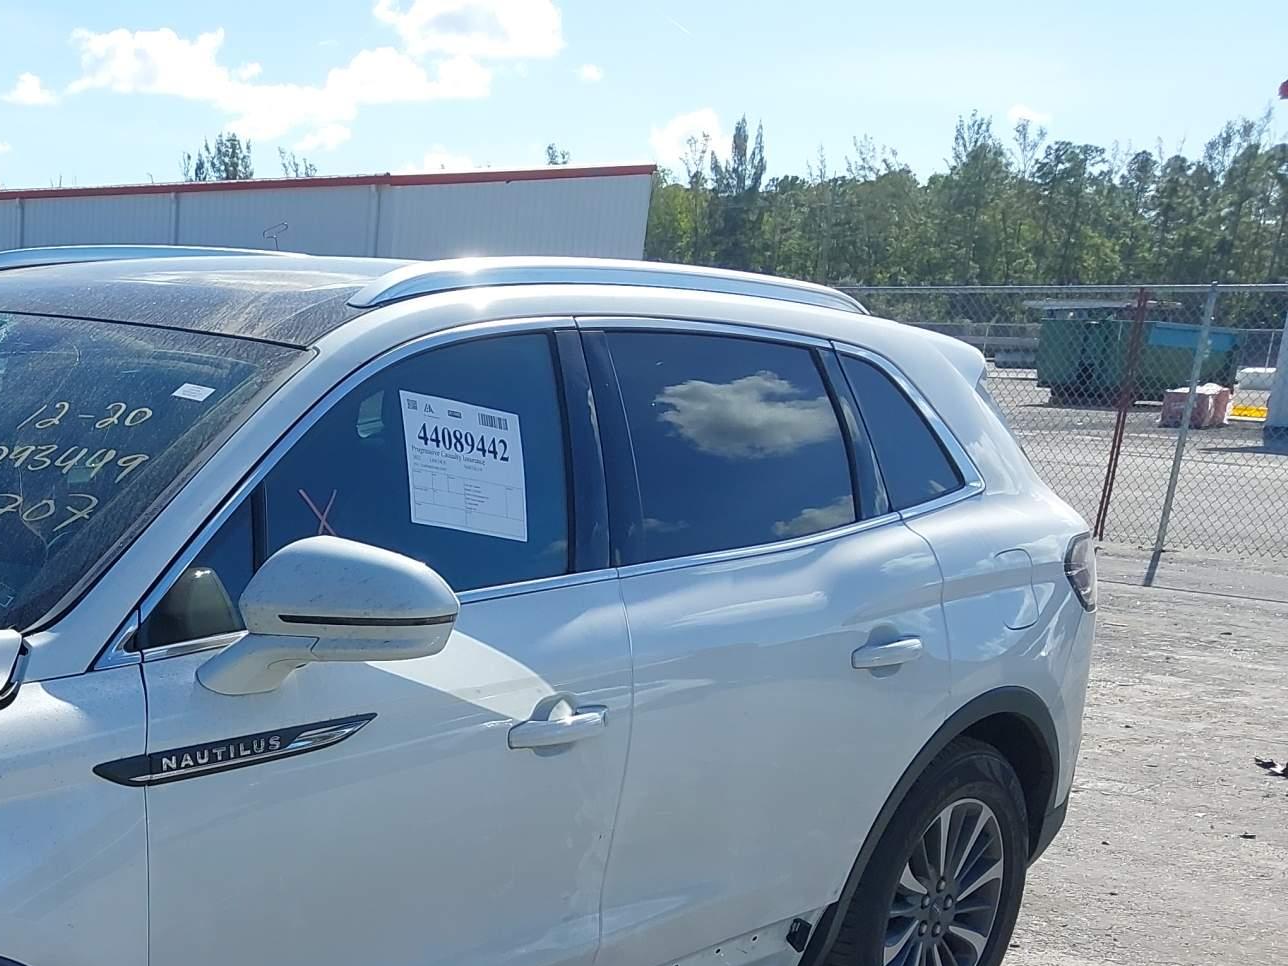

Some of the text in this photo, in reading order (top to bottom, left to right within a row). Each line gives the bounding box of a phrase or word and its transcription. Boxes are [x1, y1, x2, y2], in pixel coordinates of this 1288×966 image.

[16, 401, 153, 430] 12-20
[417, 422, 510, 463] 44089442
[161, 735, 282, 772] NAUTILUS
